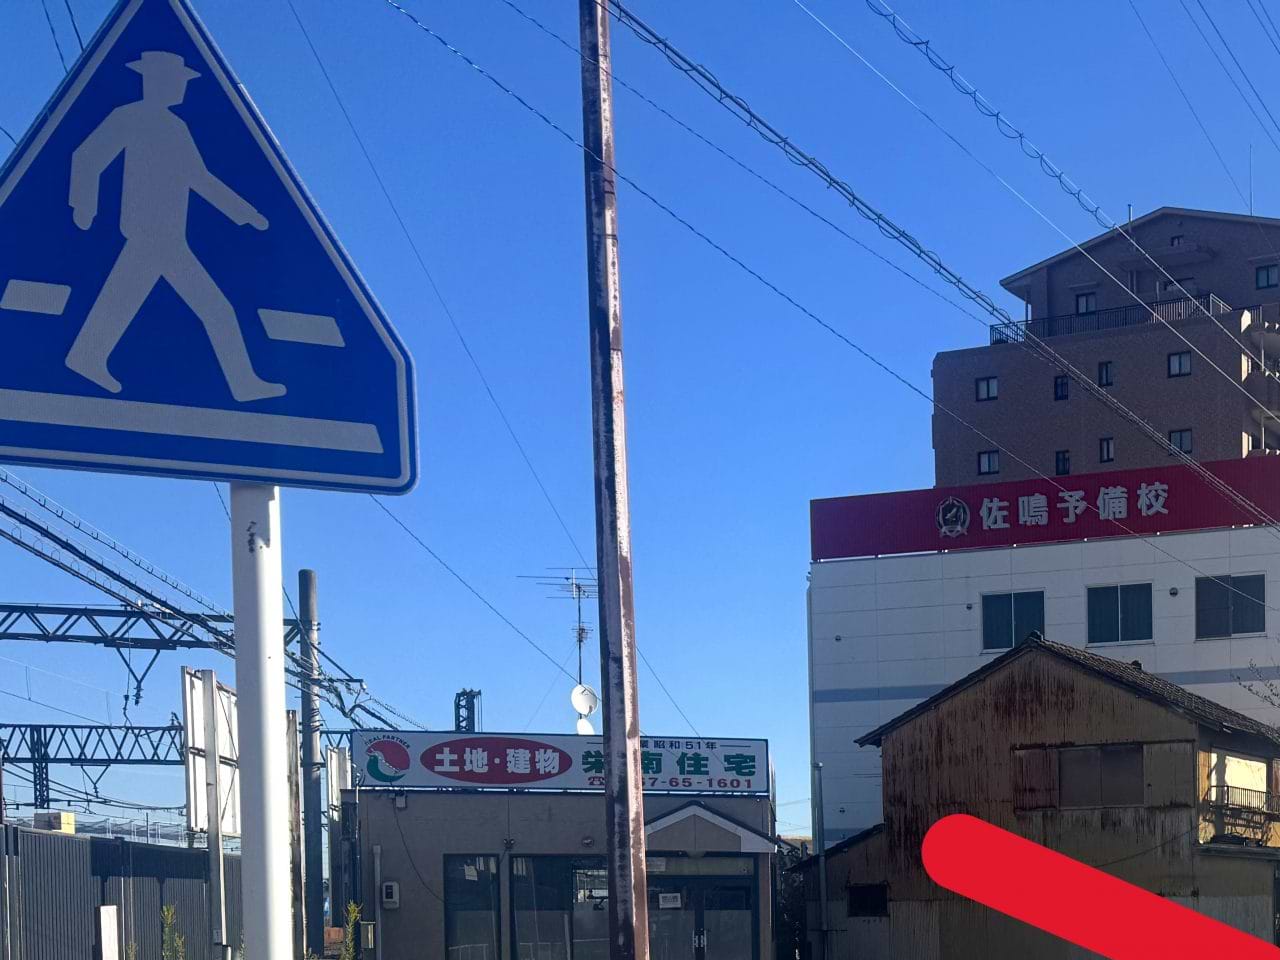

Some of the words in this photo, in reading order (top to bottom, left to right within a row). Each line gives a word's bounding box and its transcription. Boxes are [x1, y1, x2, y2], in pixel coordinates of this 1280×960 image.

[980, 482, 1169, 529] 佐鳴予備校
[433, 747, 560, 774] 土地・建物
